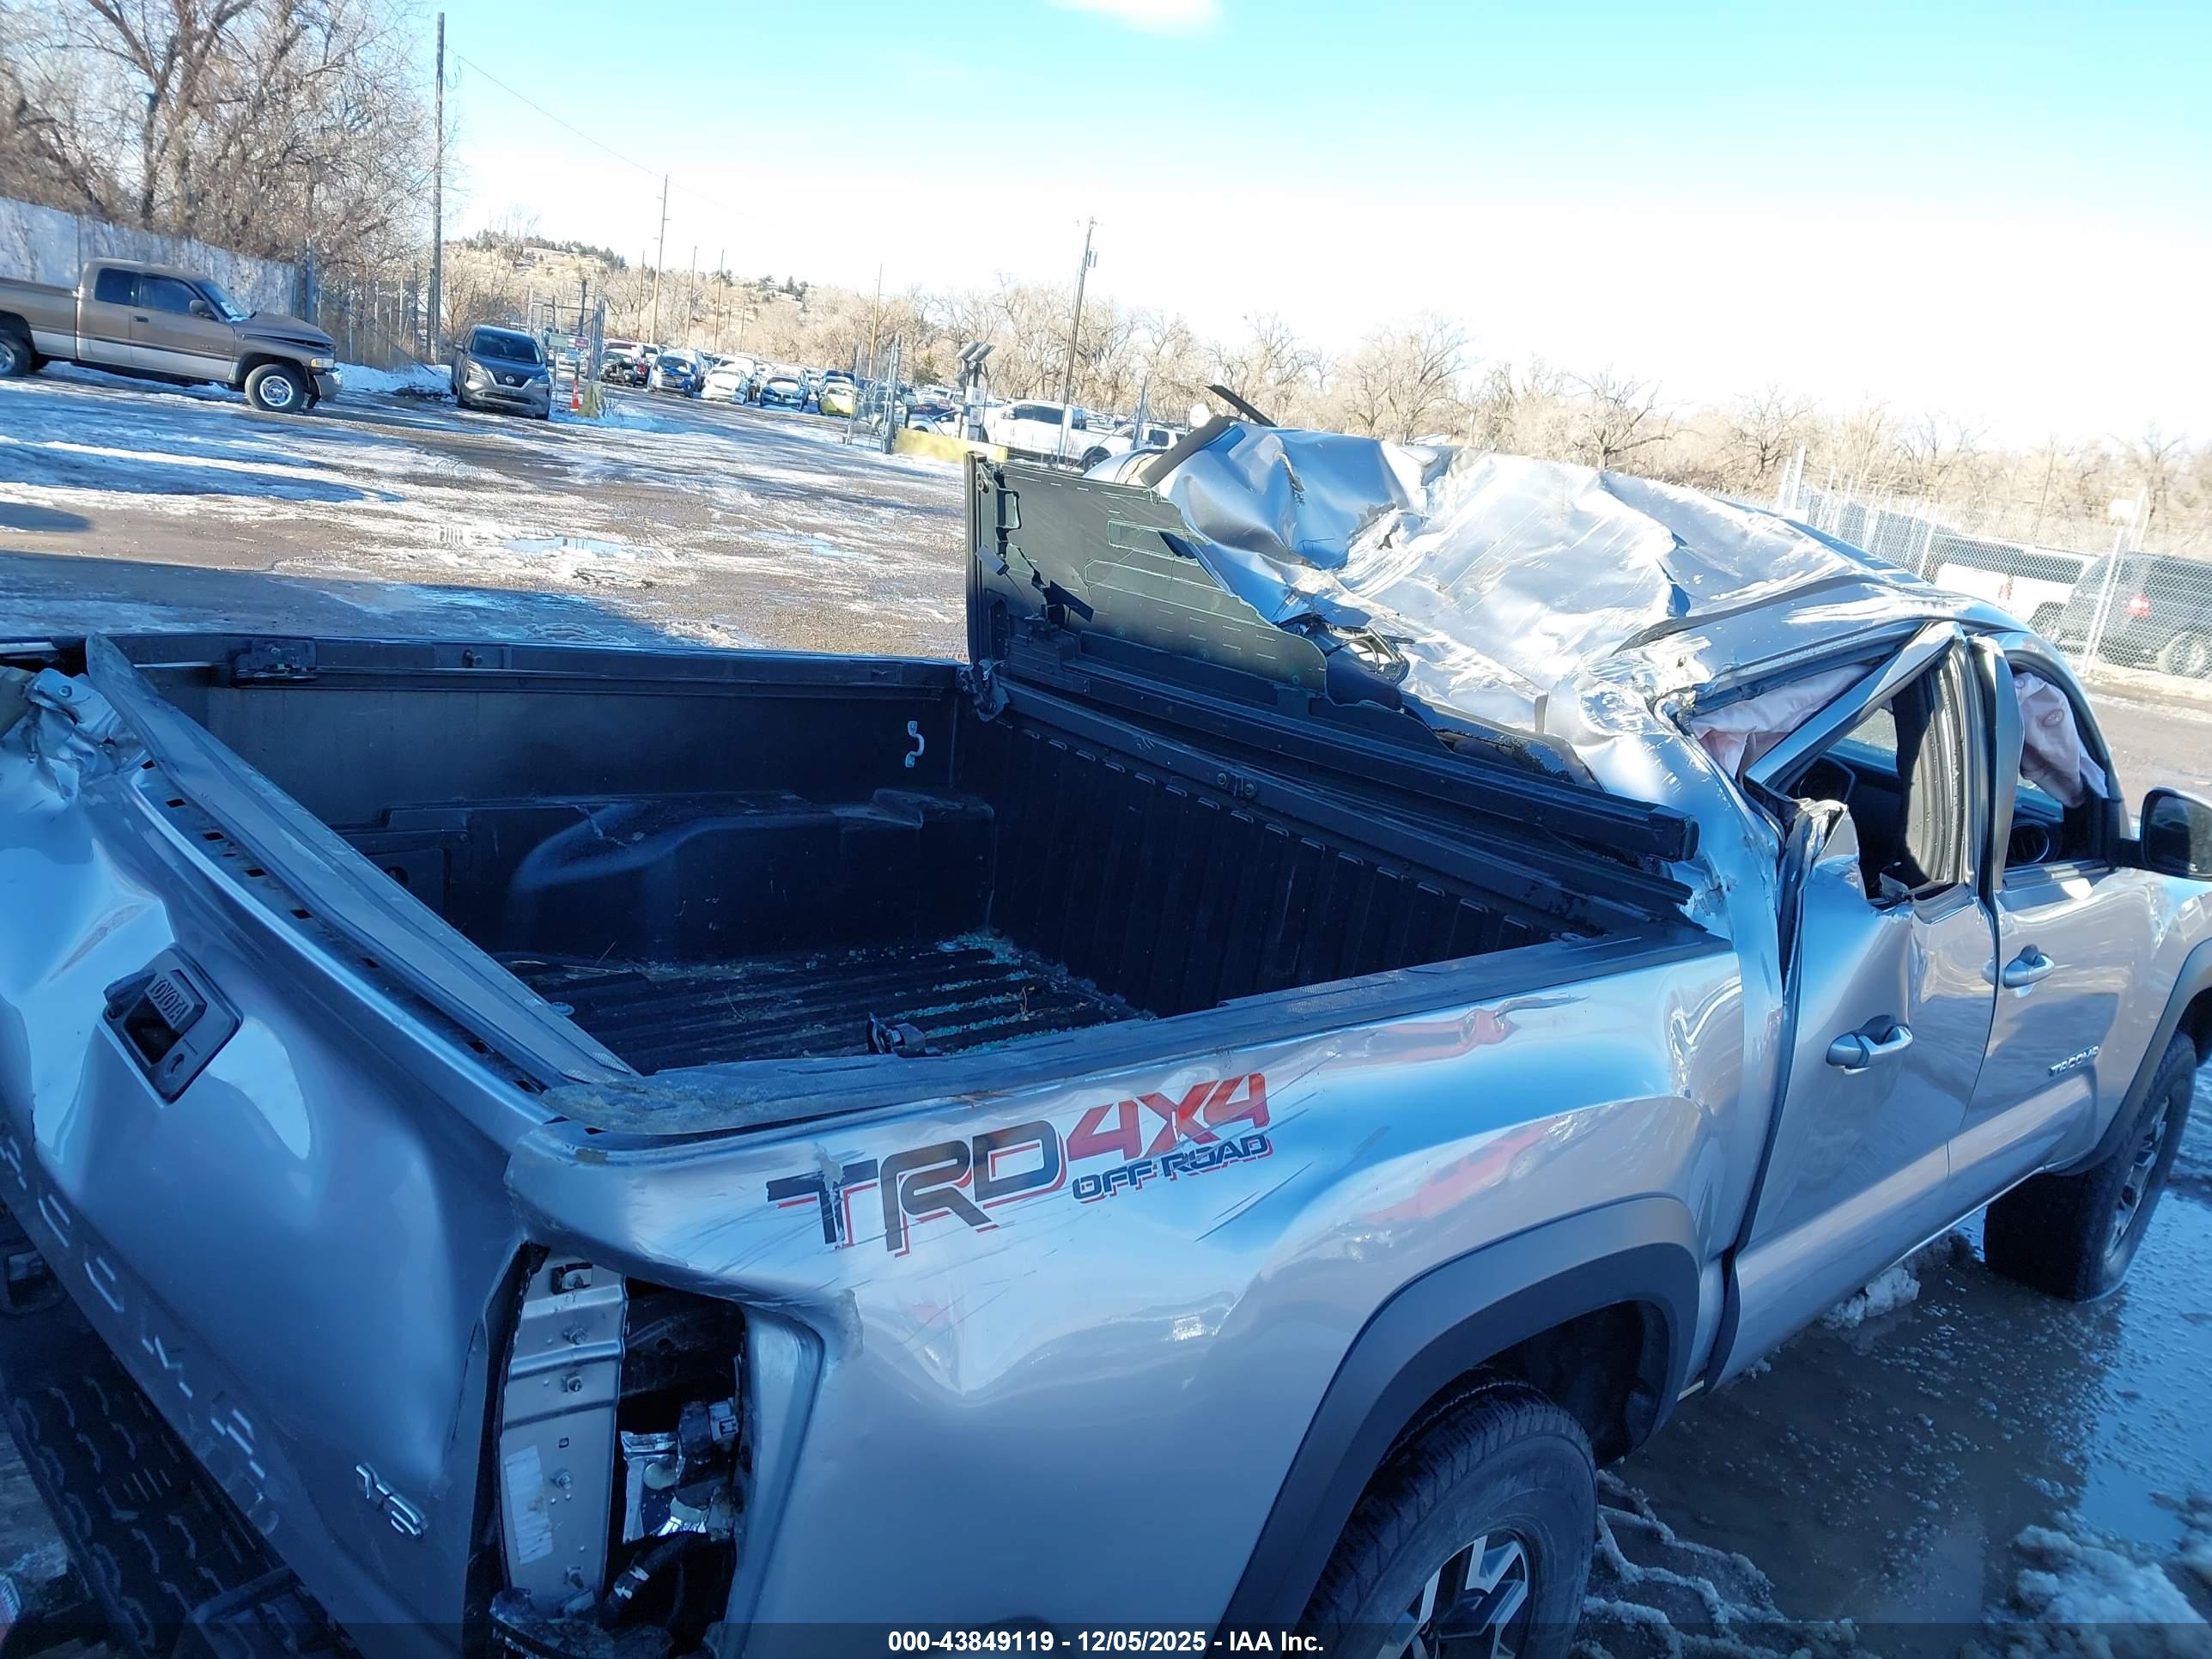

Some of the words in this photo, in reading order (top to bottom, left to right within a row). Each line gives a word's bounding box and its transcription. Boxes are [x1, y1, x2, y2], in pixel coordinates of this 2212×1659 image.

[150, 976, 189, 1024] TOYOTA
[767, 1120, 1066, 1258] TRD
[1073, 1165, 1157, 1204] OFF
[1163, 1132, 1273, 1182] ROAD
[355, 1463, 424, 1537] V6
